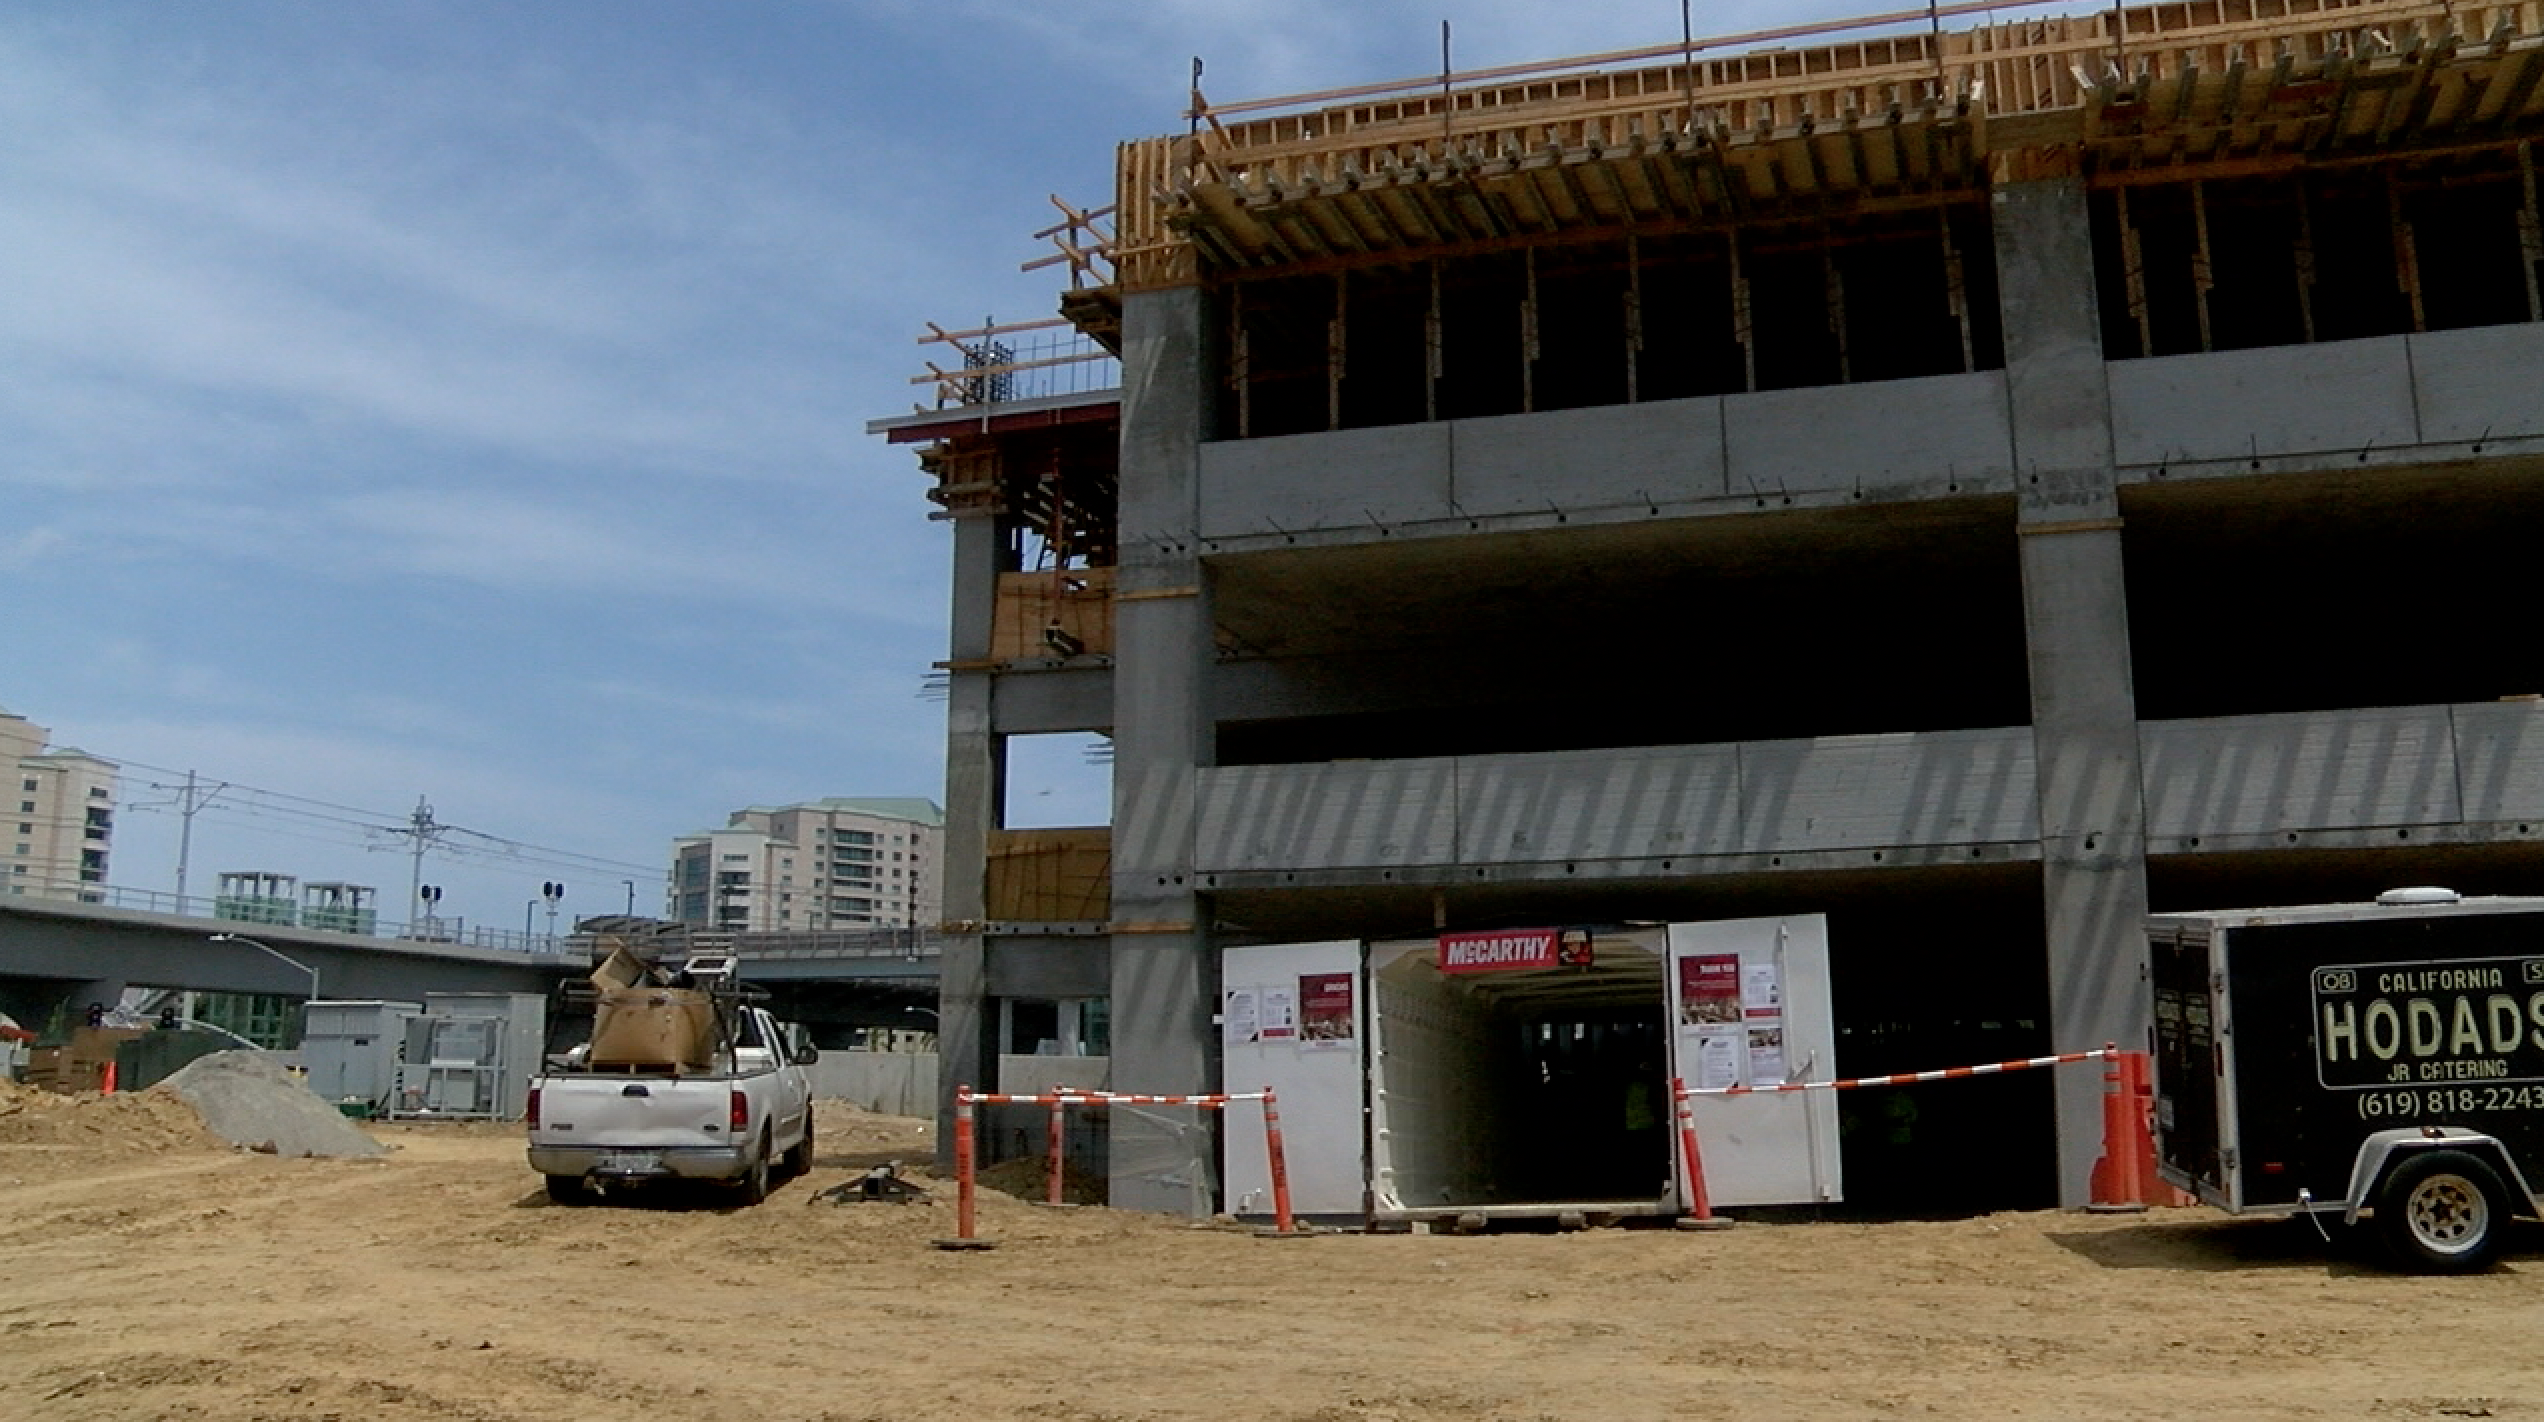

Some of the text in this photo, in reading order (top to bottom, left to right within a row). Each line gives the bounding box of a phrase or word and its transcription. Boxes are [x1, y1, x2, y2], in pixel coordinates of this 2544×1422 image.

[2323, 976, 2351, 990] OB
[2379, 968, 2503, 993] CALIFORNIA
[2387, 1059, 2508, 1082] JR CATERING
[2358, 1086, 2544, 1120] (619) 818-2243
